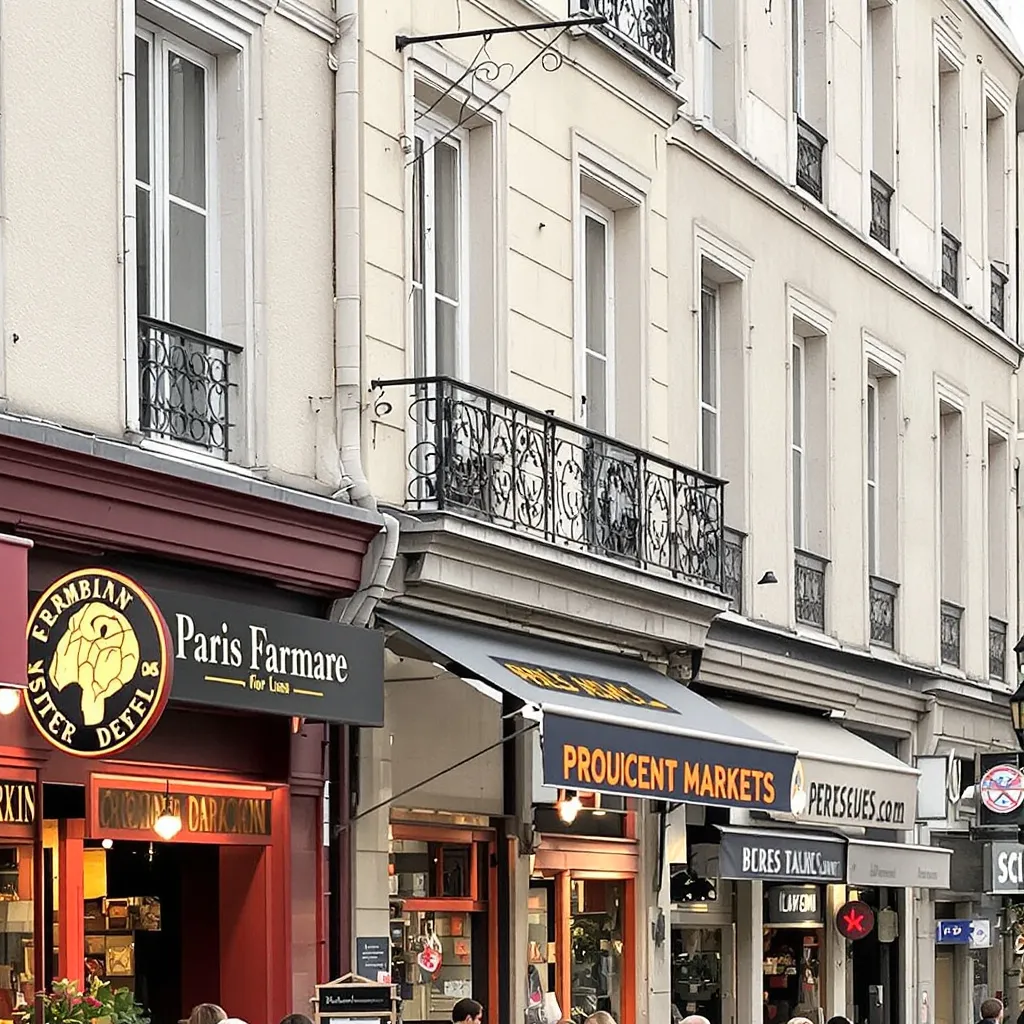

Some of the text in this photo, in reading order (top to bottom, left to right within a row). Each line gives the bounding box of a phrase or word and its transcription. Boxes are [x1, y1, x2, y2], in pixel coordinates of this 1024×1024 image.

[176, 613, 348, 683] Paris Farmare
[684, 761, 775, 804] MARKETS
